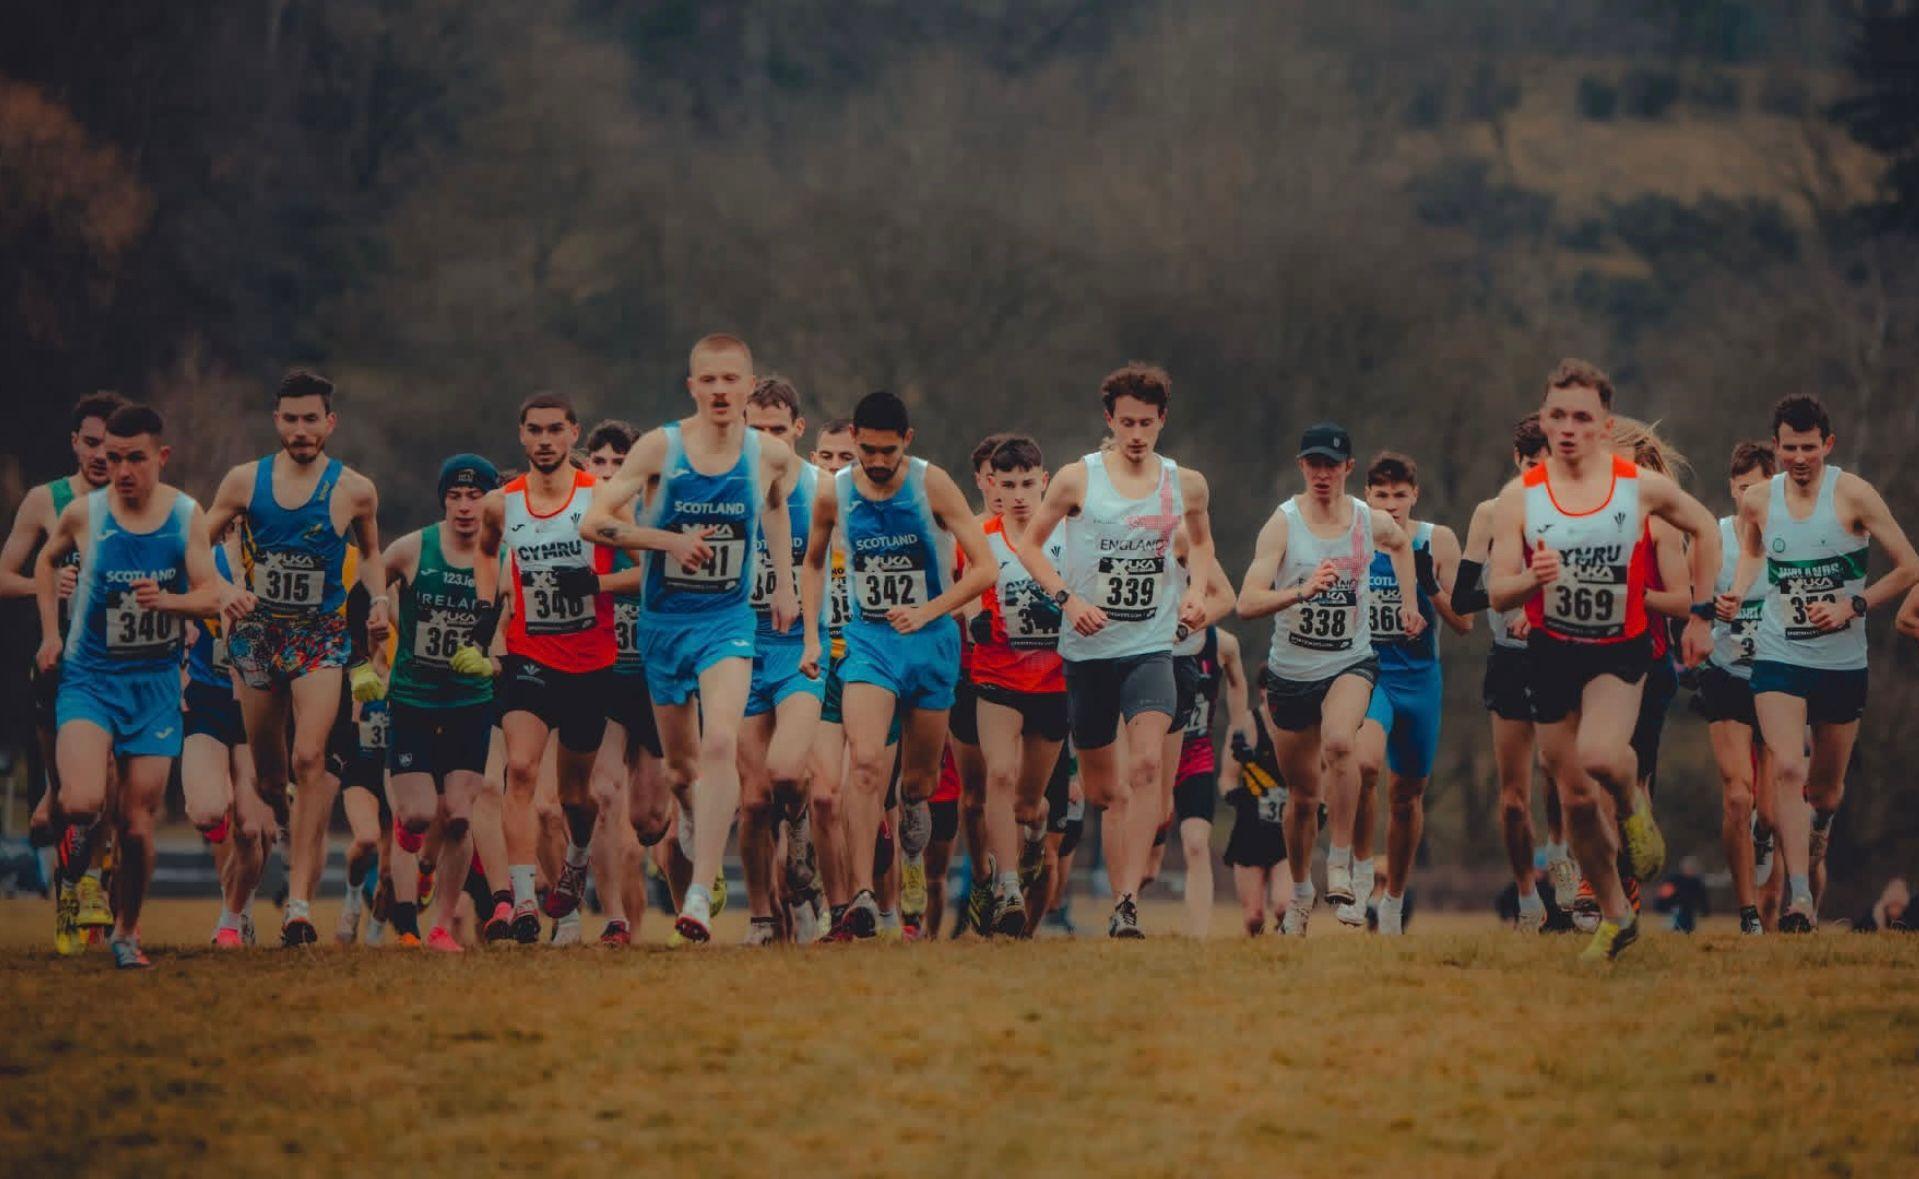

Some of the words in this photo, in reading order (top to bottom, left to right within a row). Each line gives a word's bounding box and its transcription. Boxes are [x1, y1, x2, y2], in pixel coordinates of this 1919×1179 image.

[674, 501, 745, 515] SCOTLAND
[518, 540, 582, 561] CYMRU
[856, 534, 918, 551] SCOTLAND
[1560, 545, 1621, 567] YMRU
[681, 545, 729, 576] 41
[266, 569, 310, 602] 315
[866, 574, 915, 606] 342
[1106, 577, 1155, 606] 339
[1556, 585, 1614, 621] 369
[119, 611, 171, 643] 340
[1299, 607, 1346, 637] 338
